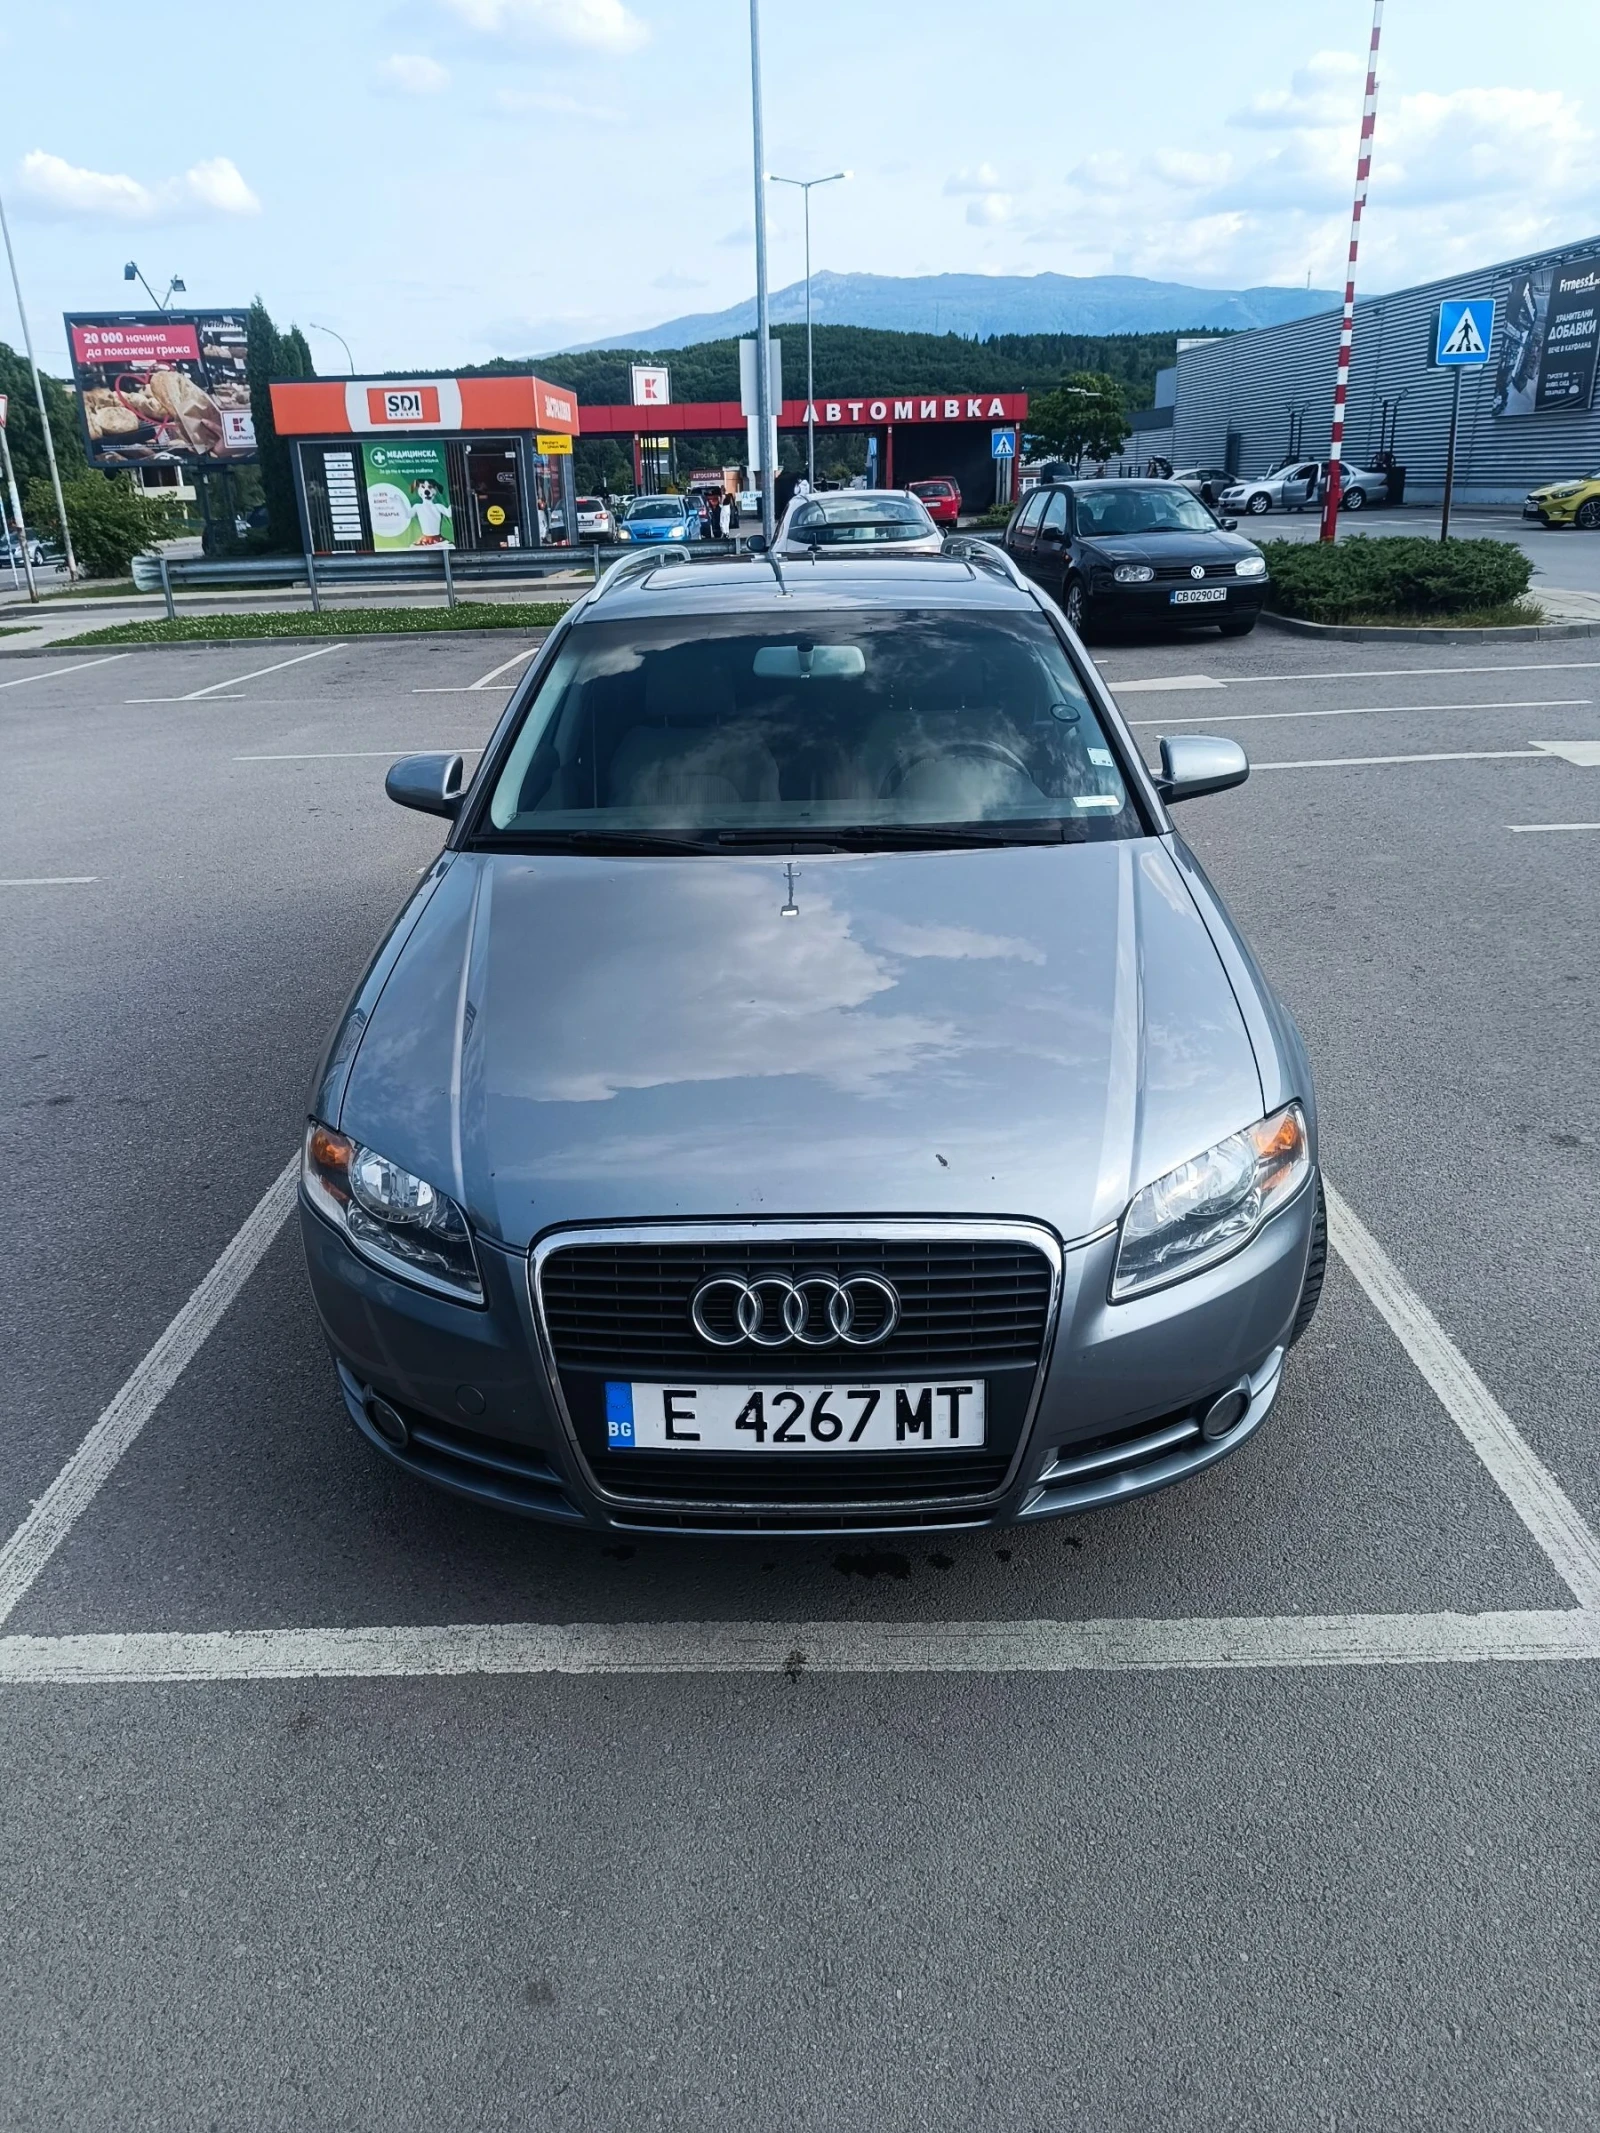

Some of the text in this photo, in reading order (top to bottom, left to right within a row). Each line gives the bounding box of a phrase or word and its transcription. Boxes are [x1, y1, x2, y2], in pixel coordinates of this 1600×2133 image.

[1555, 308, 1594, 323] ХРАНИТЕЛНИ
[1547, 319, 1597, 341] ДОБАВКИ
[83, 332, 167, 344] 20 000 начина
[86, 345, 191, 359] да покажеш грижа
[1564, 341, 1592, 351] КАУФЛАНД
[387, 394, 420, 412] SDI
[802, 398, 1005, 422] АВТОМИВКА
[386, 449, 438, 460] МЕДИЦИНСКА
[1176, 589, 1226, 602] CB 0290 CH
[662, 1386, 974, 1443] E 4267 MT
[608, 1422, 632, 1437] BG
